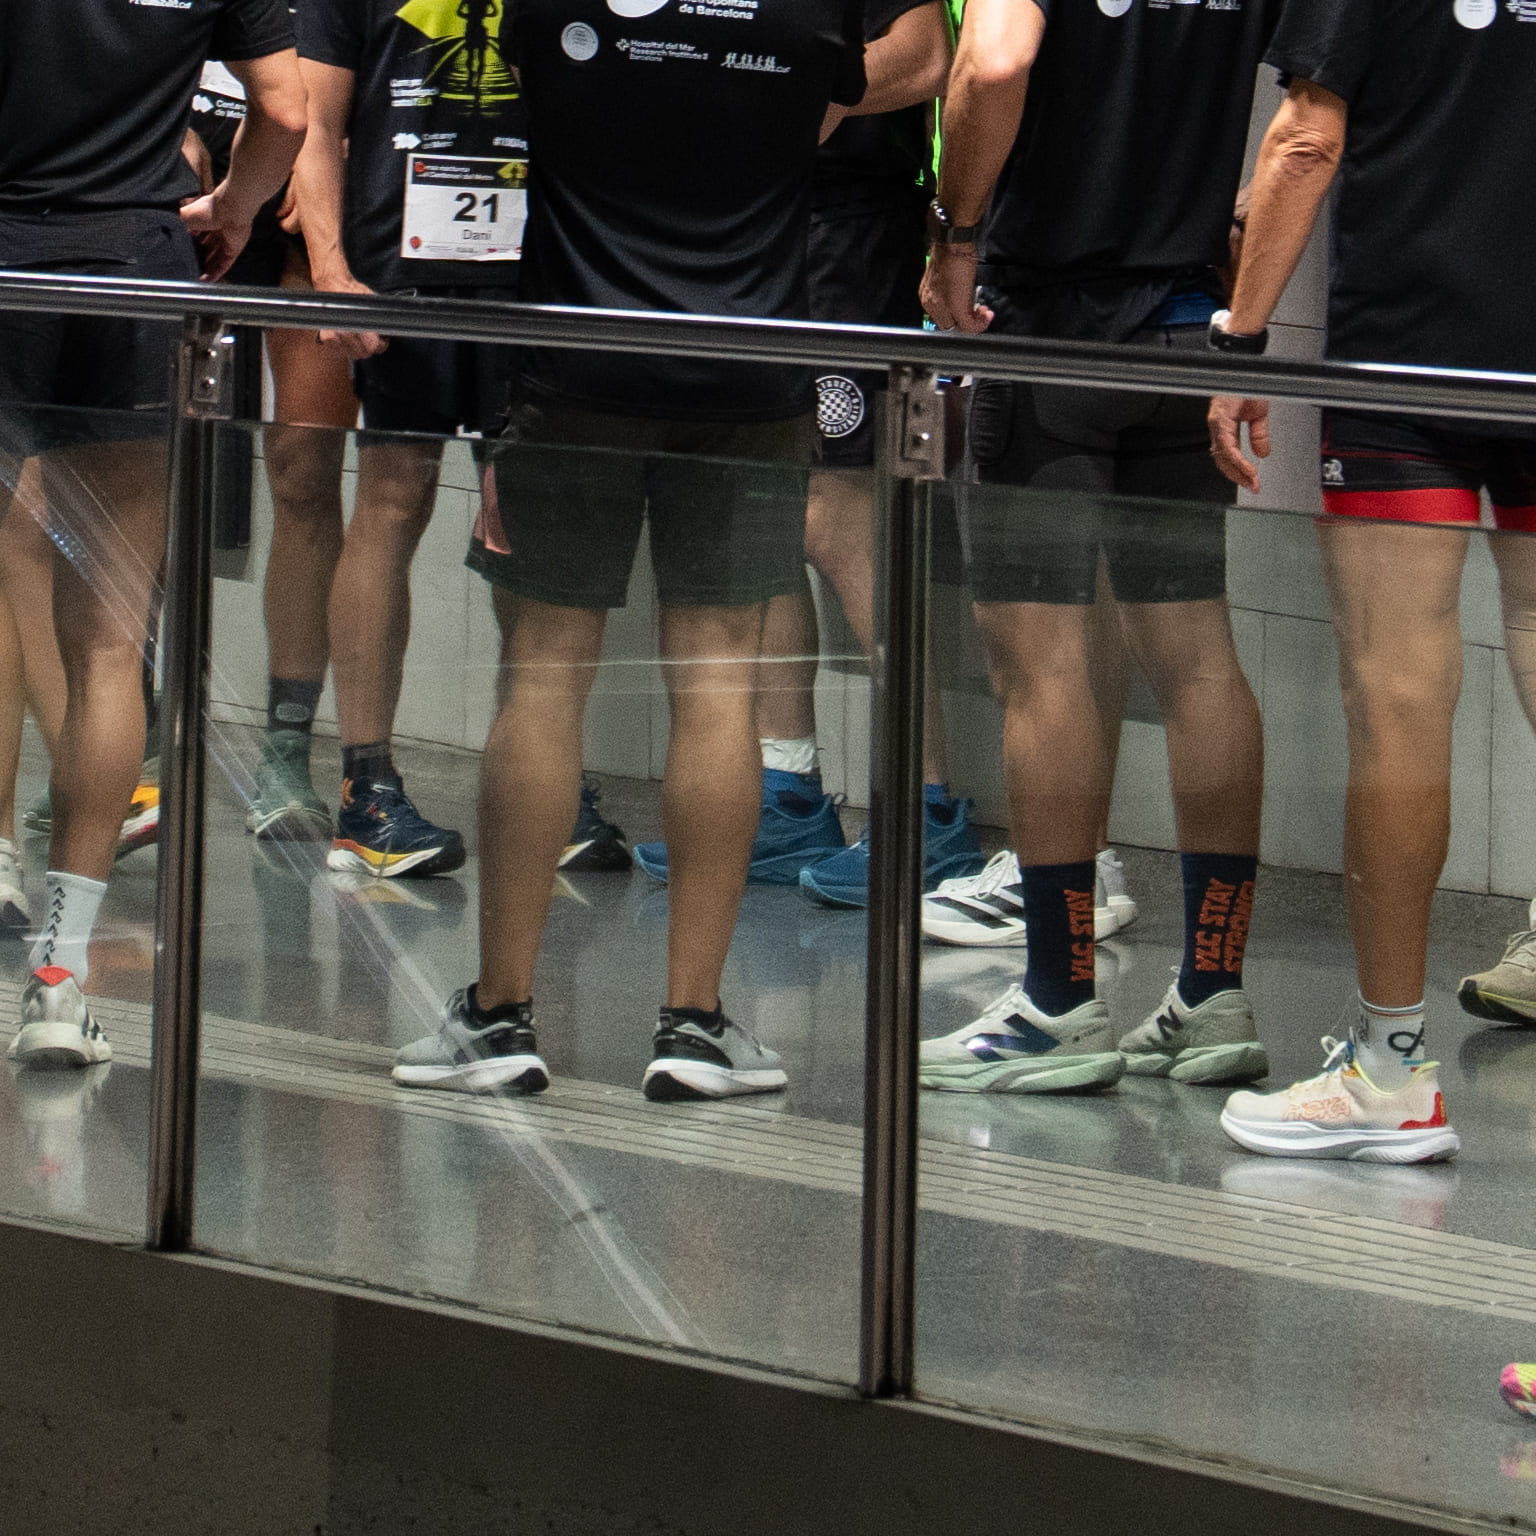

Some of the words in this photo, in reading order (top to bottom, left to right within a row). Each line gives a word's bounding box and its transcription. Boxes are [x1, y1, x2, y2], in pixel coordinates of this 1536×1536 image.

[679, 4, 694, 14] de
[696, 5, 754, 20] Barcelona
[452, 192, 500, 223] 21
[463, 229, 492, 240] Dani
[1199, 877, 1237, 928] STAY
[1194, 931, 1222, 972] VLC
